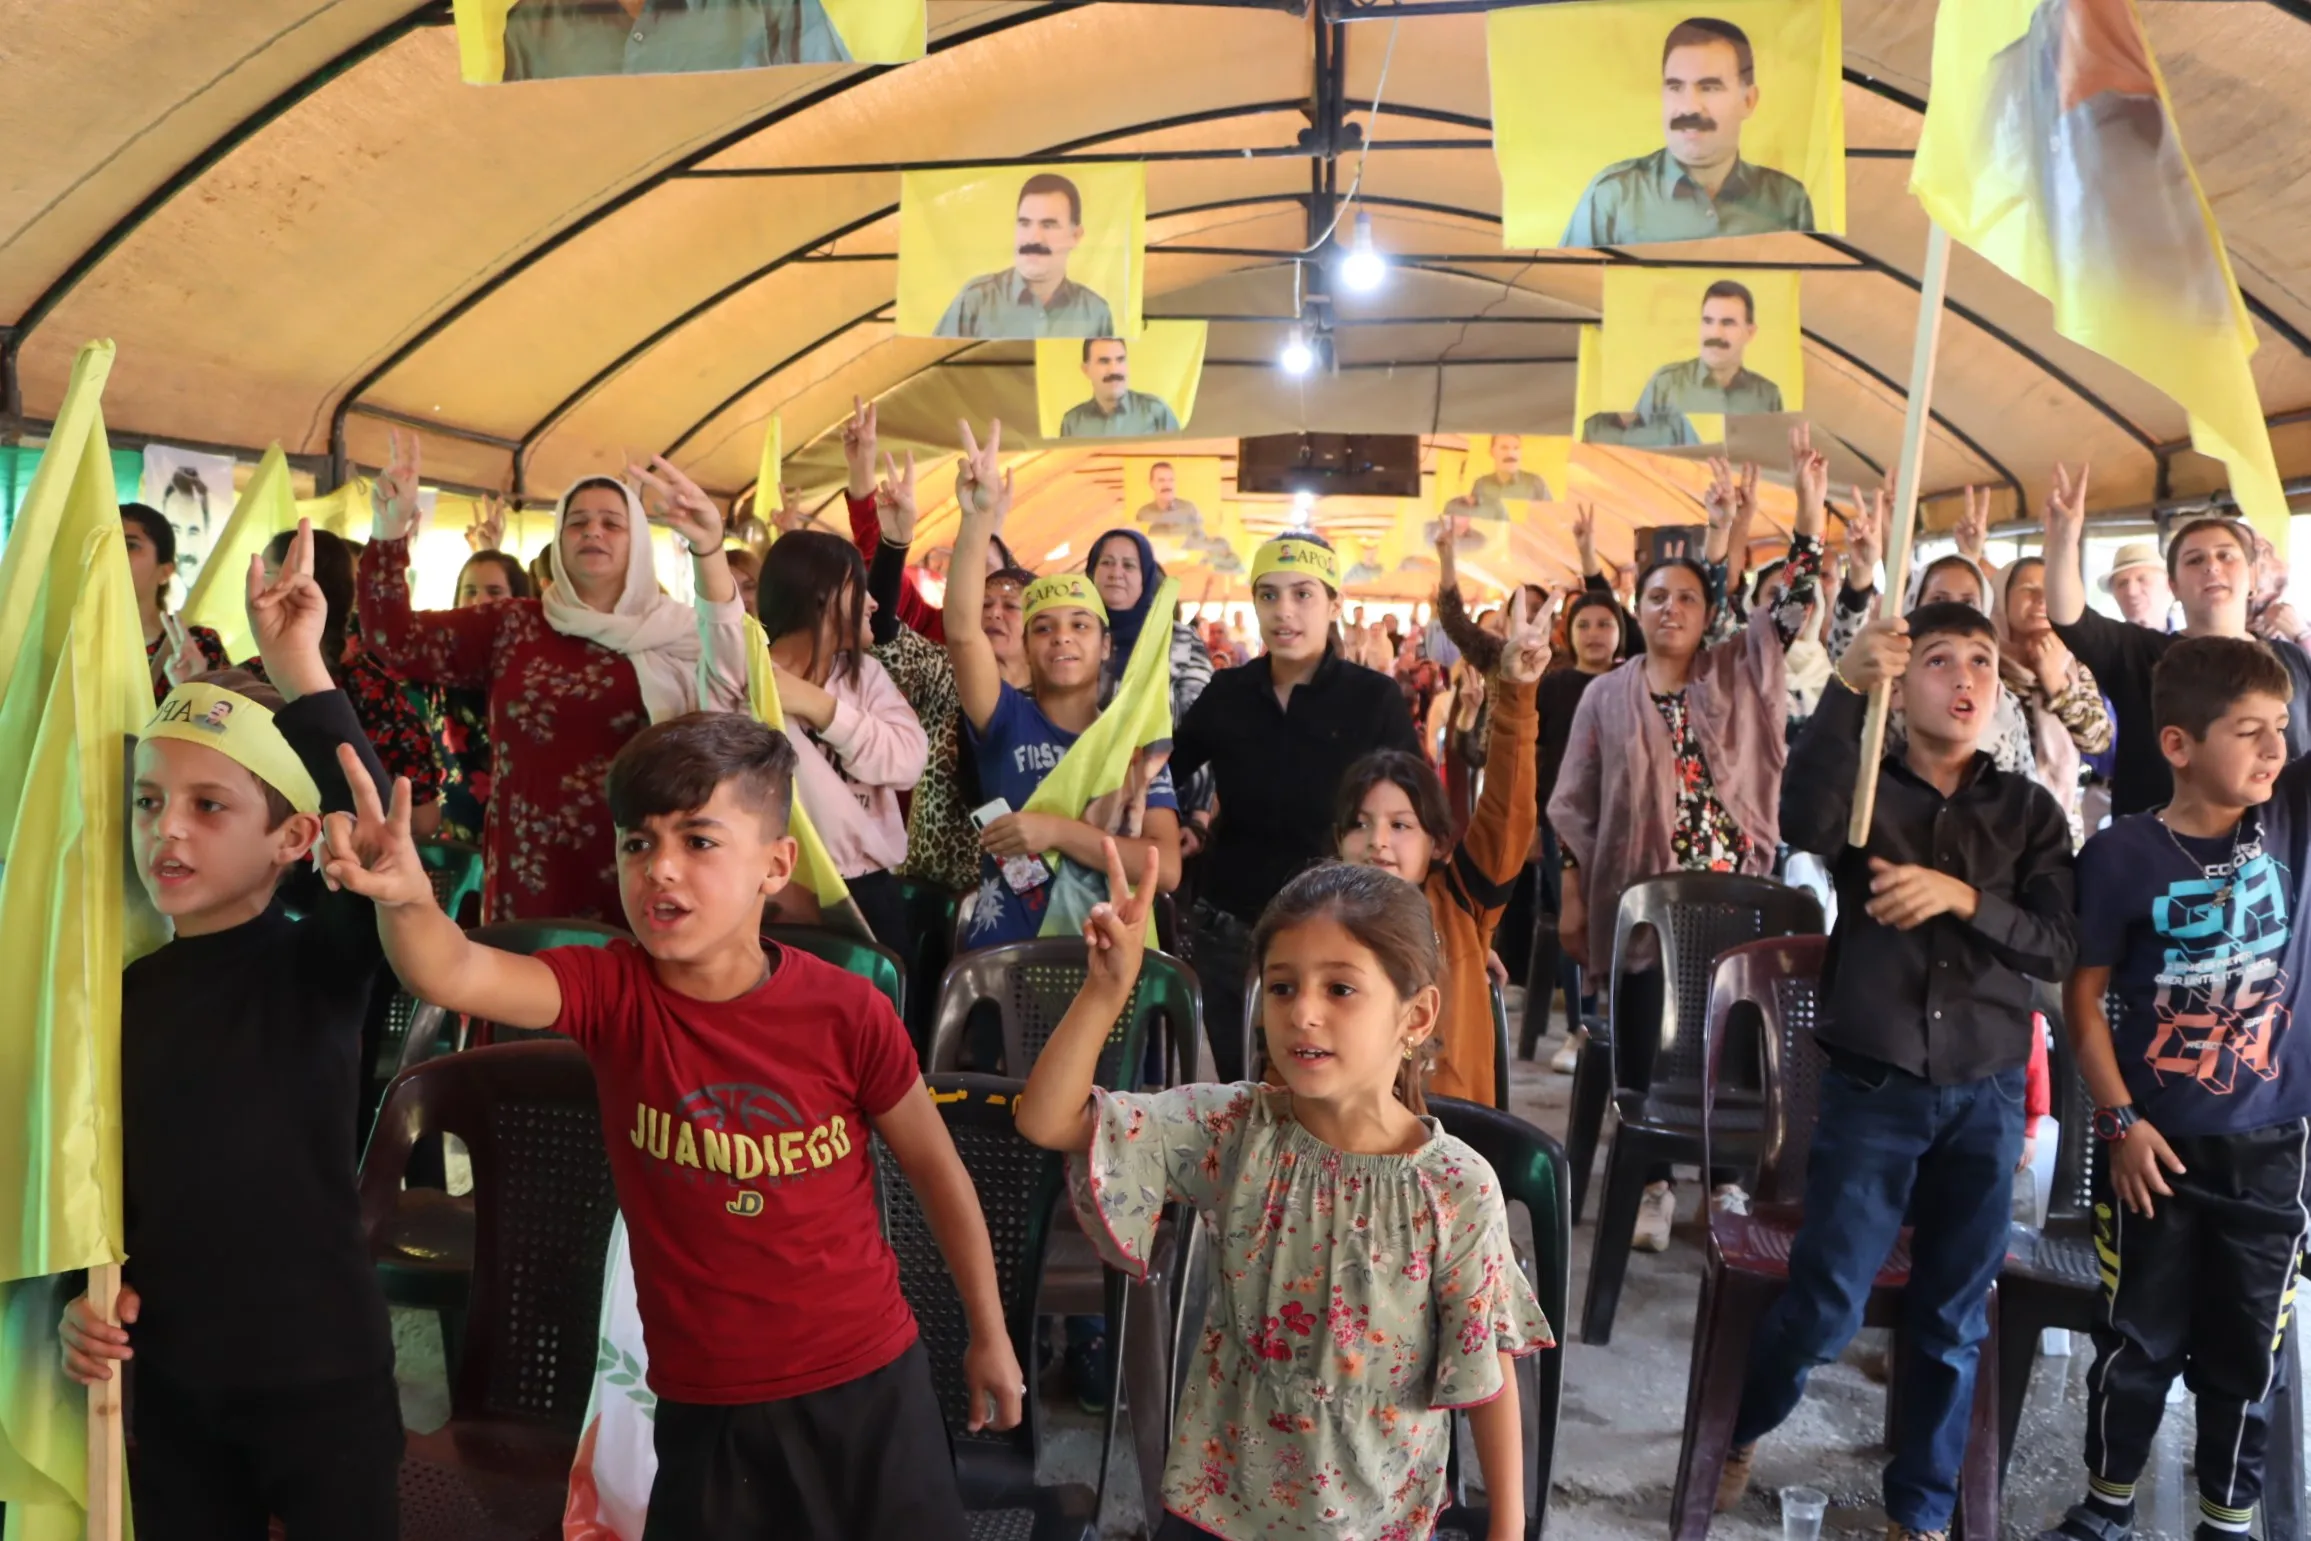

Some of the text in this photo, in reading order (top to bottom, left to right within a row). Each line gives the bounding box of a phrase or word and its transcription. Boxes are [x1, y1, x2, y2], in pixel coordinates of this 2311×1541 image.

[1297, 549, 1327, 569] APO
[1035, 584, 1069, 601] APO
[2184, 973, 2220, 986] UNTIL
[630, 1102, 851, 1180] JUANDIEGO
[725, 1190, 764, 1217] JD
